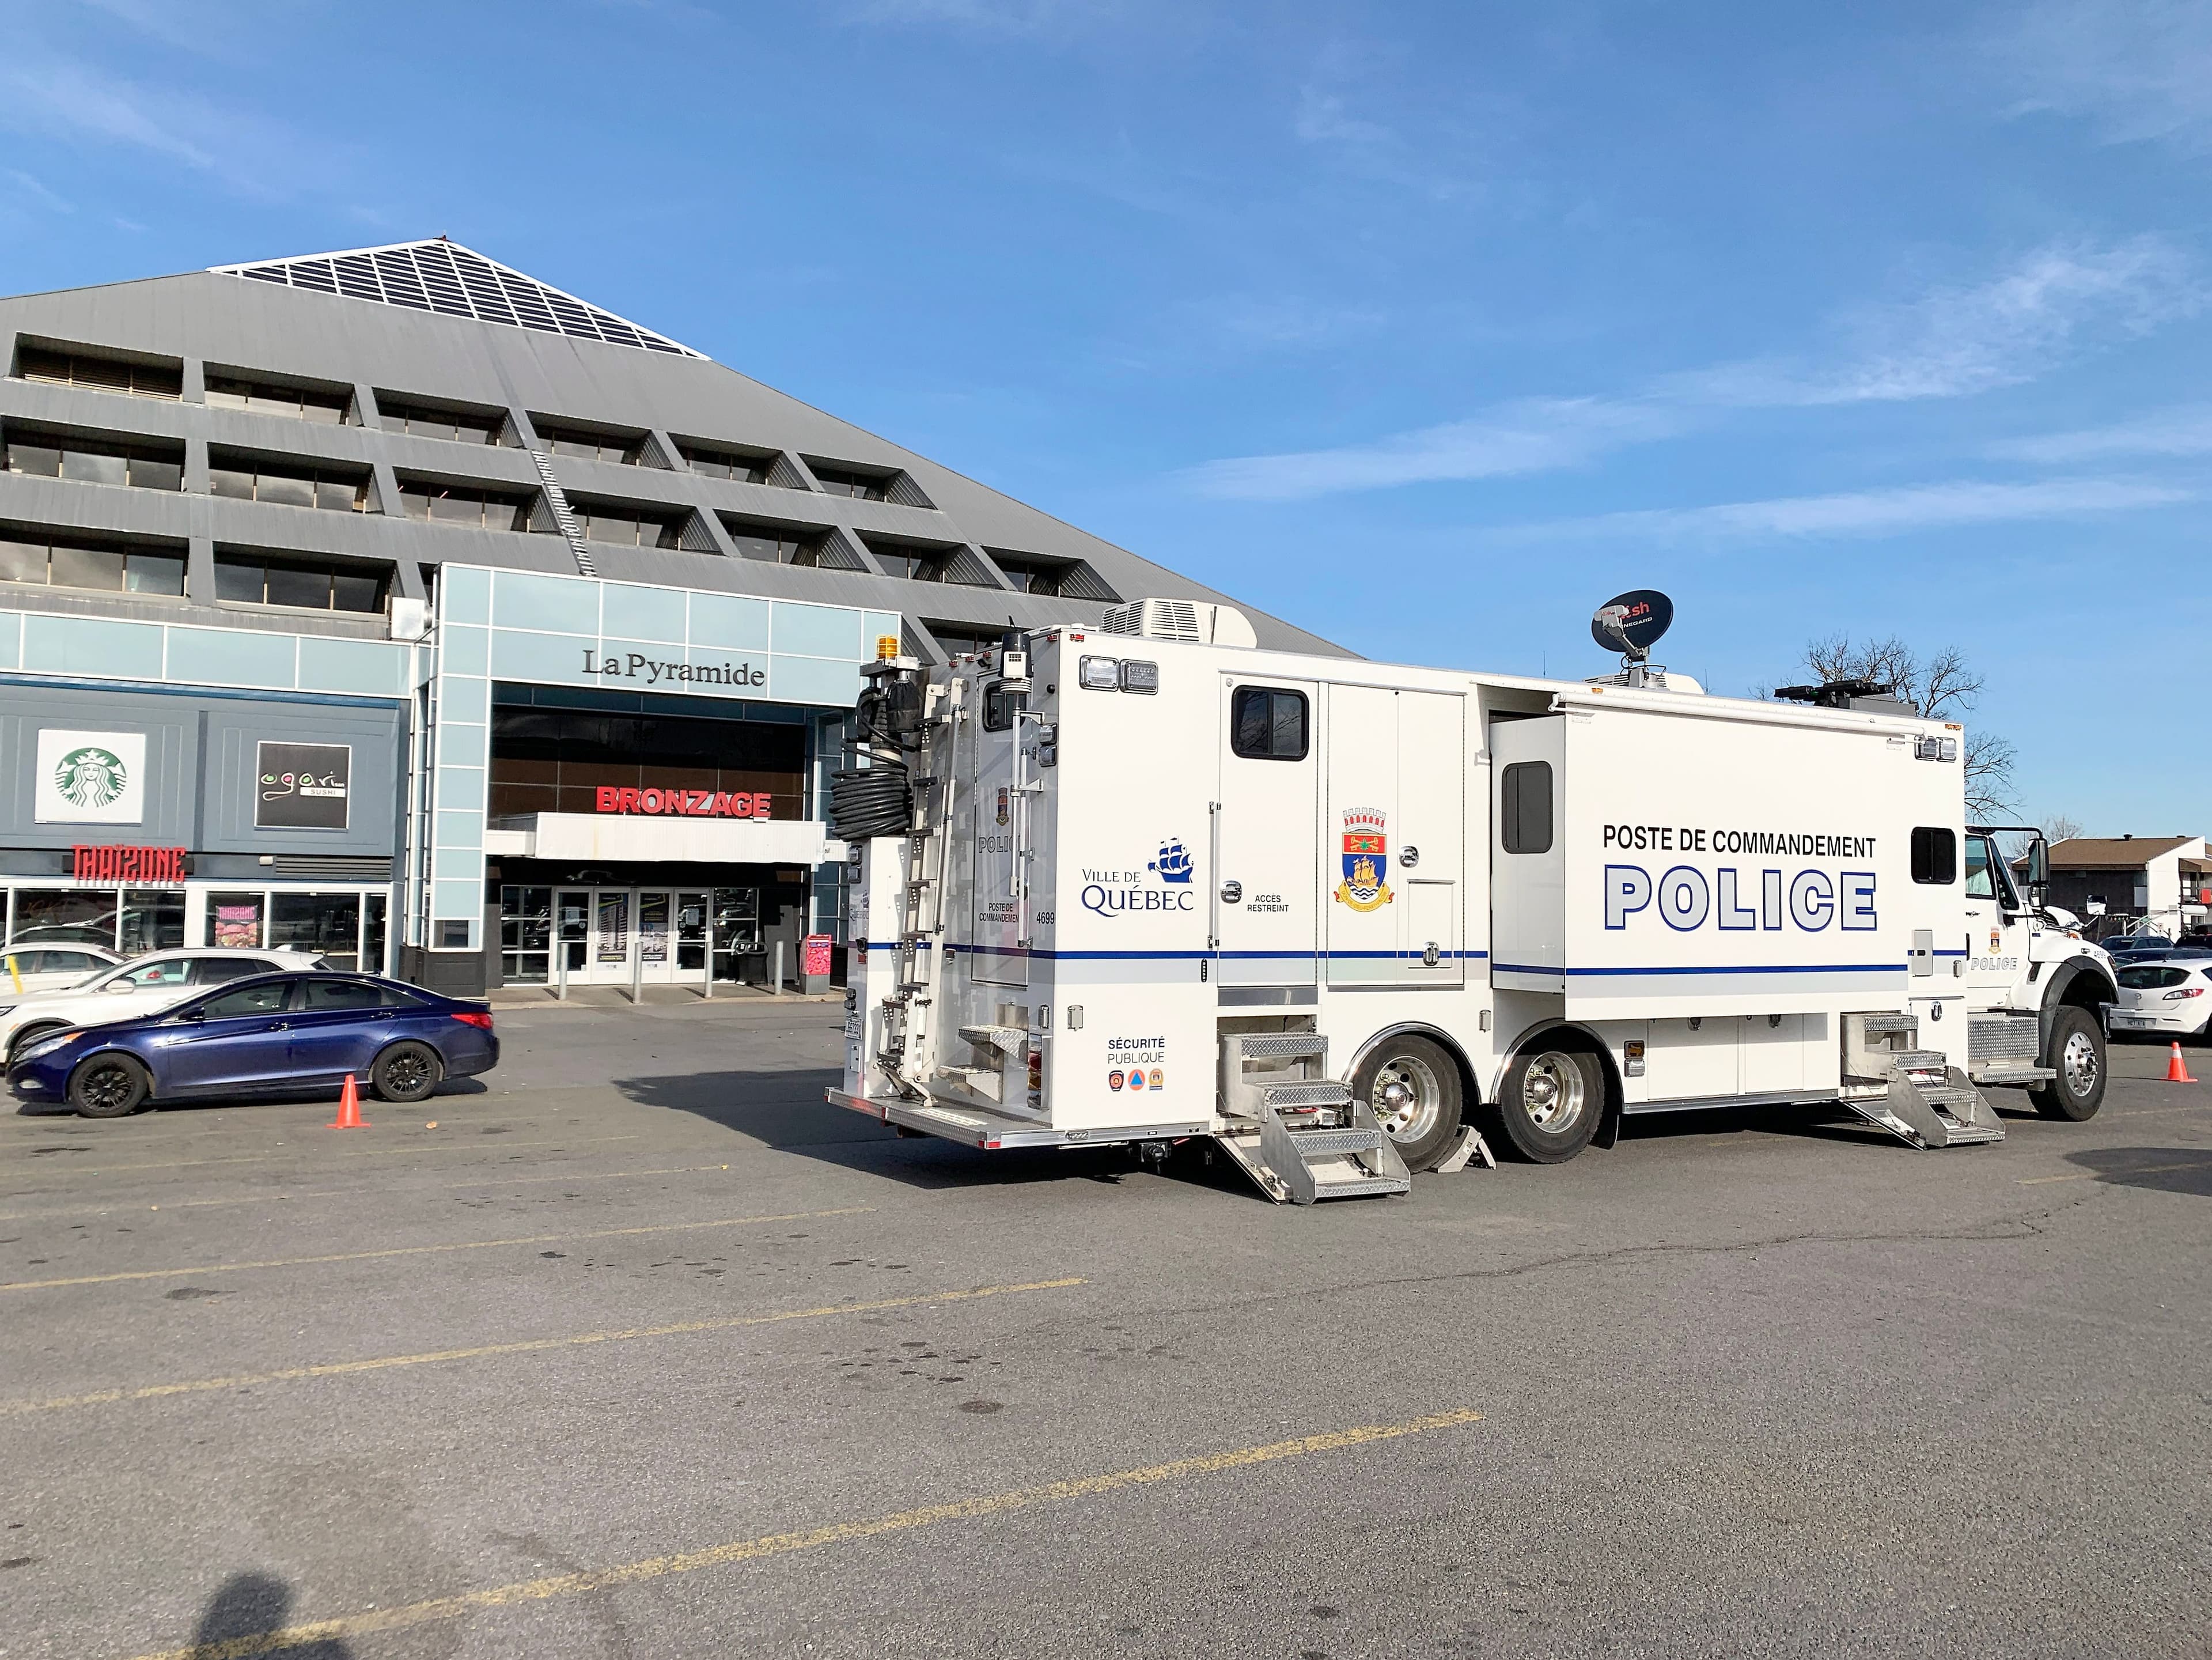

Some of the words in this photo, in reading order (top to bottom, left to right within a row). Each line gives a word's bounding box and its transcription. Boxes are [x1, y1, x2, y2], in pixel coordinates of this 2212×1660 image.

[1622, 617, 1653, 628] NEGARD
[582, 649, 620, 675] La
[624, 653, 765, 686] Pyramide
[596, 786, 771, 817] BRONZAGE
[1604, 825, 1673, 850] POSTE
[1680, 829, 1706, 852] DE
[1713, 830, 1876, 858] COMMANDEMENT
[1082, 868, 1120, 882] VILLE
[1124, 872, 1141, 883] DE
[1081, 885, 1194, 917] QUÉBEC
[1604, 864, 1877, 932] POLICE
[988, 903, 1005, 912] POSTE
[1006, 903, 1013, 912] DE
[1247, 904, 1289, 912] RESTREINT
[979, 913, 1019, 923] COMMANDEMEN
[1036, 912, 1055, 925] 4699
[1971, 958, 2018, 970] POLICE
[1108, 1035, 1165, 1049] SÉCURITÉ
[1108, 1052, 1164, 1064] PUBLIQUE
